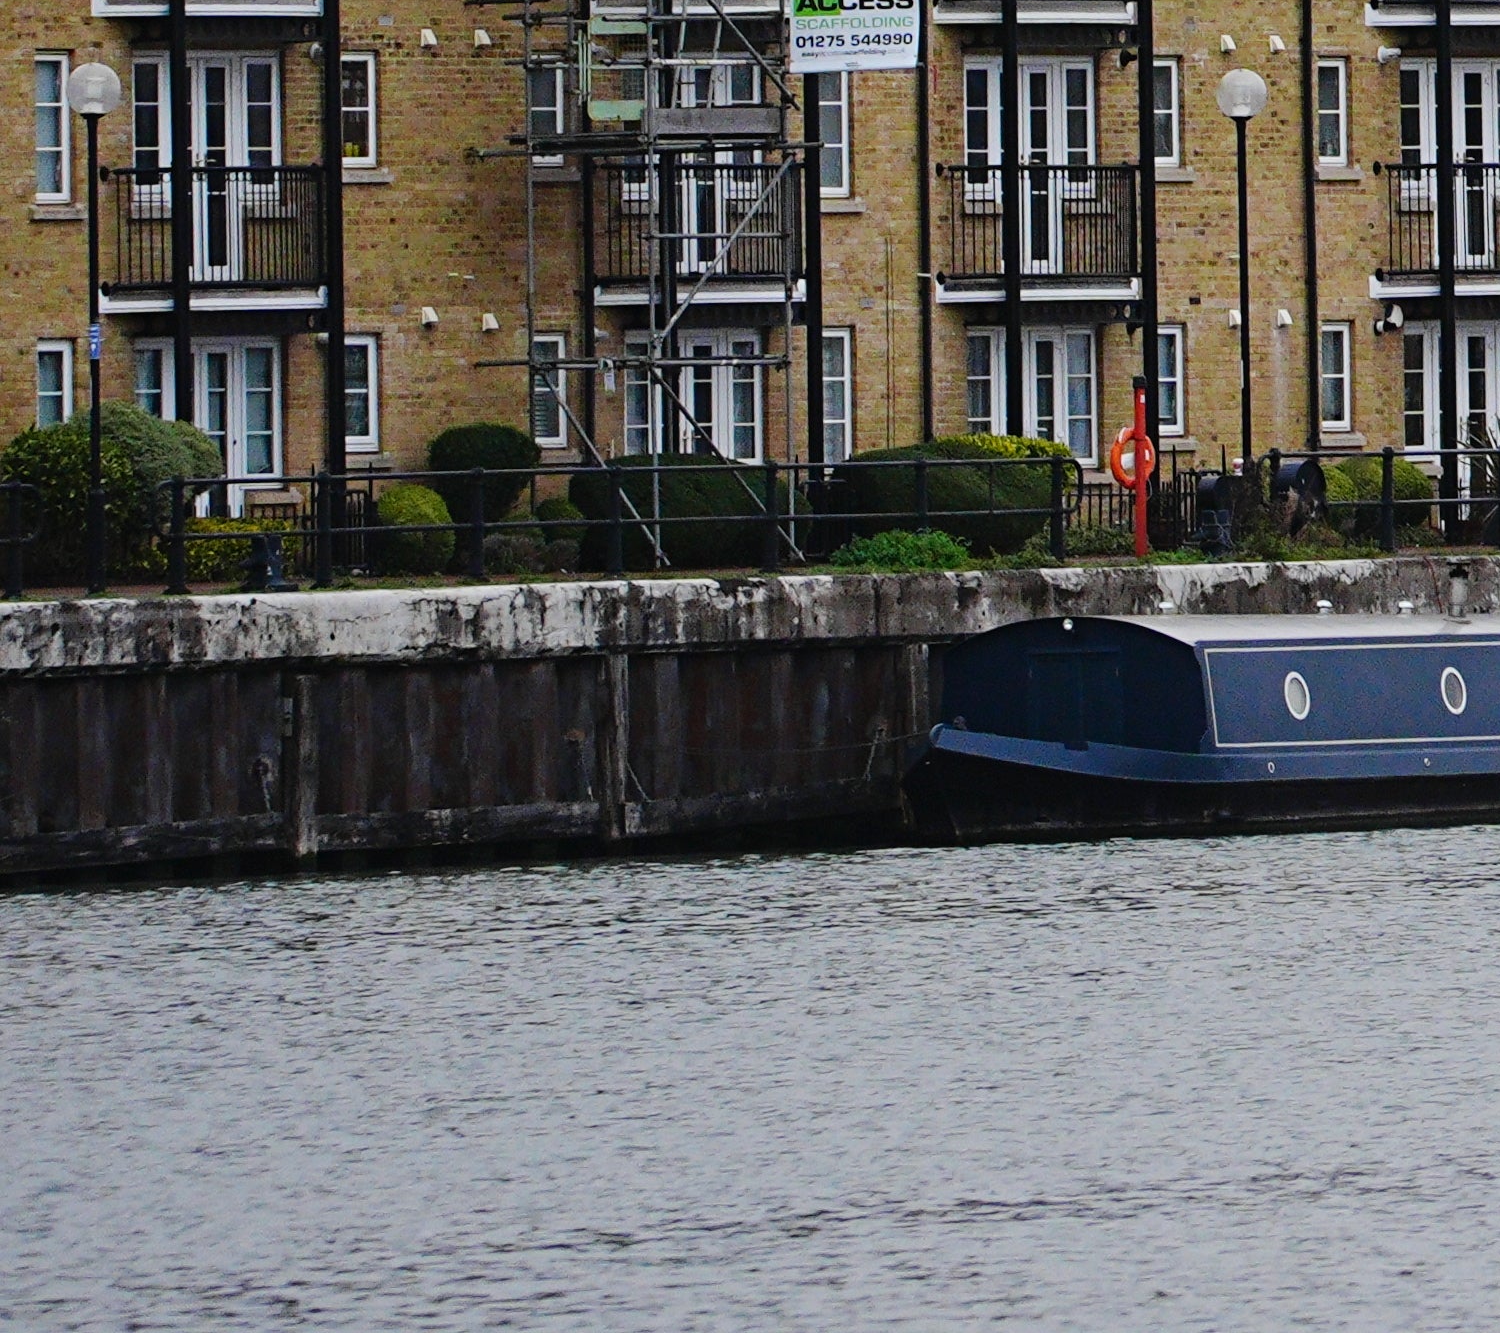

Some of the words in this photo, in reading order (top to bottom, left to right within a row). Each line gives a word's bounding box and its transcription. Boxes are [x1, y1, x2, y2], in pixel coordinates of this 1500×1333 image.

[795, 16, 914, 31] SCAFFOLDING
[796, 34, 845, 48] 01275
[850, 33, 913, 47] 544990
